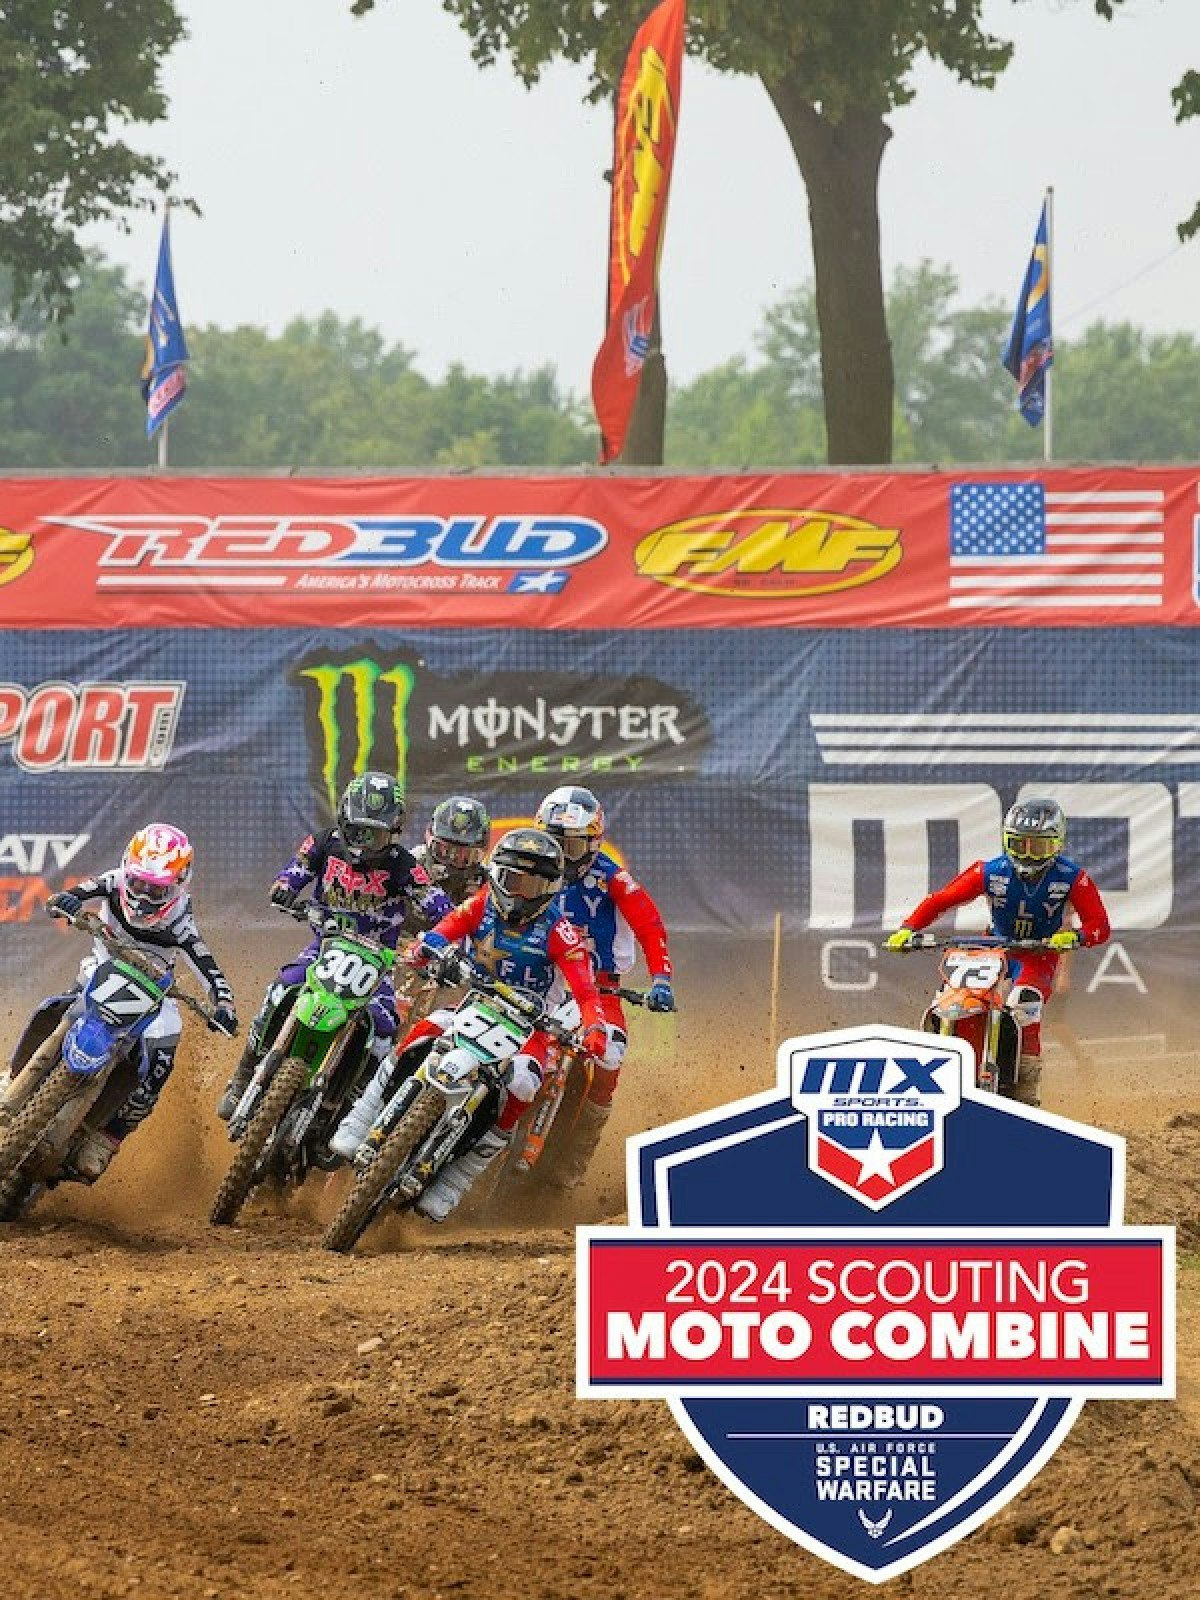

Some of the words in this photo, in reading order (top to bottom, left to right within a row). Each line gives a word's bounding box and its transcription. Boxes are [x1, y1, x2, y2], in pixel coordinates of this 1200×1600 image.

[43, 515, 609, 569] REDBUD
[635, 520, 903, 577] FMF
[428, 697, 687, 749] MONSTER
[467, 755, 644, 773] ENERGY
[90, 972, 160, 1026] 17
[315, 949, 379, 998] 300
[945, 956, 1003, 990] 73
